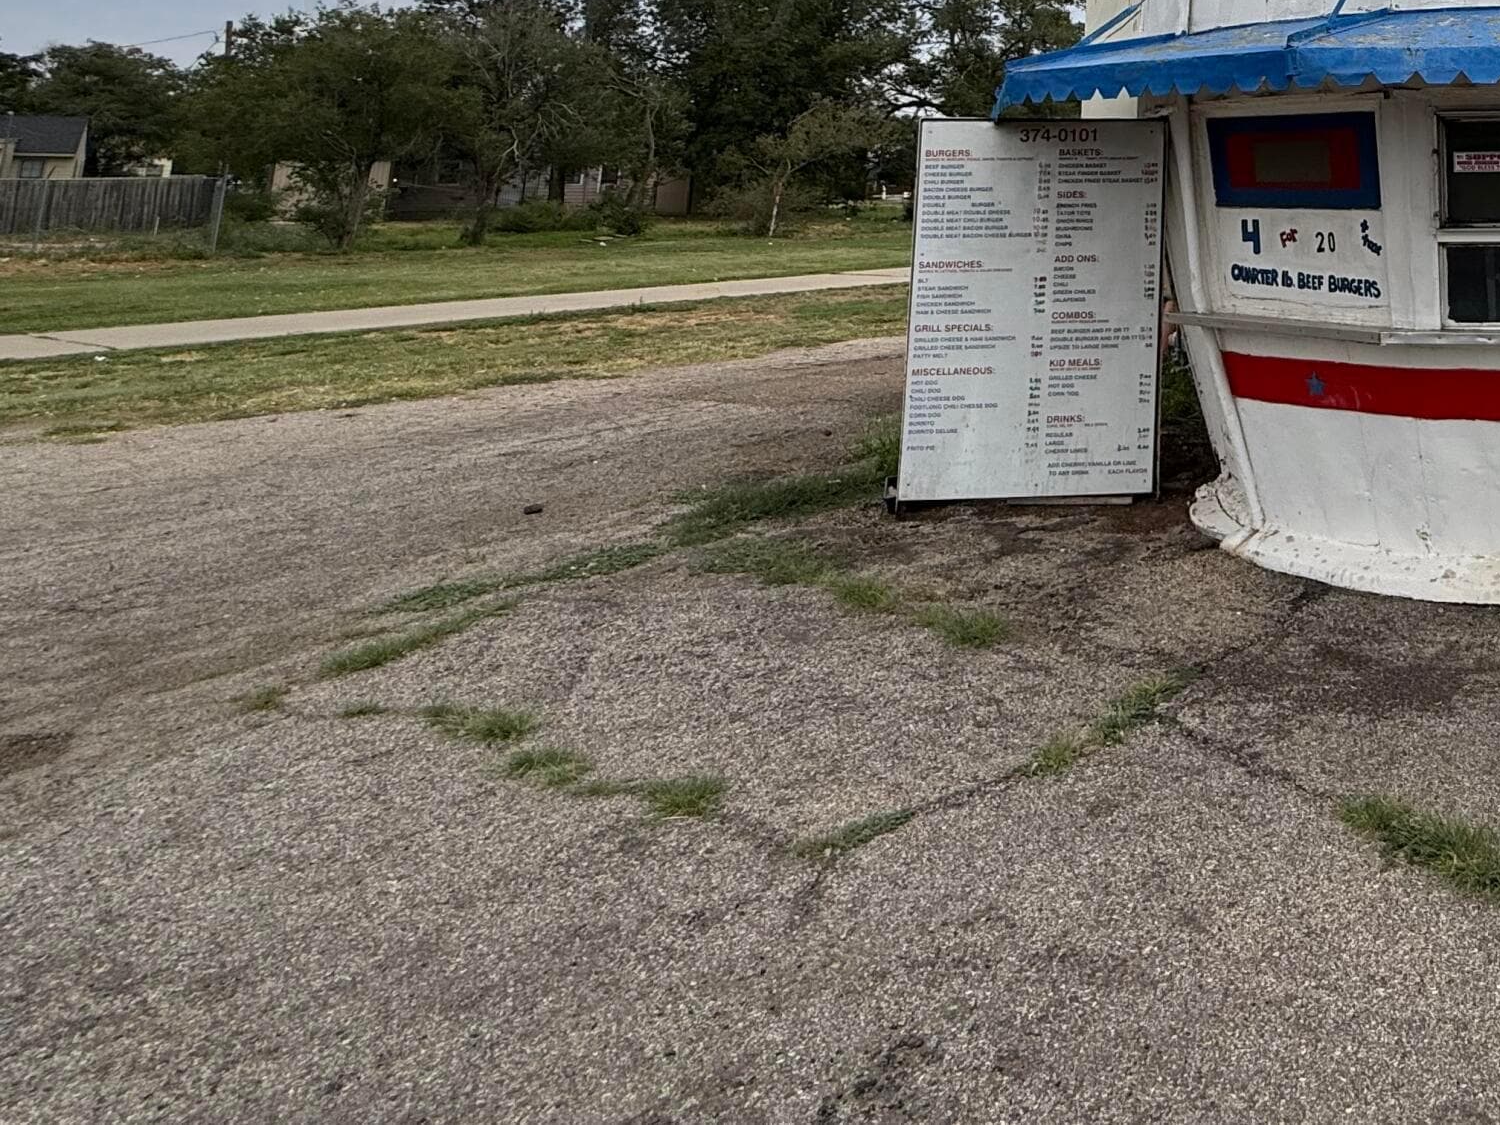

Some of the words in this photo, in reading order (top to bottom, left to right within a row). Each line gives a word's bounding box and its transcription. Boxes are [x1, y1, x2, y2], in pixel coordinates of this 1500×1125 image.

[1020, 128, 1098, 143] 374-0101
[1241, 219, 1261, 255] 4
[1315, 232, 1336, 253] 20
[1054, 255, 1074, 263] ADD
[1231, 264, 1279, 287] QUARTER
[1297, 272, 1324, 290] BEEF
[1328, 275, 1381, 299] BURGERS
[945, 324, 993, 332] SPECIALS:
[1049, 359, 1066, 367] KID
[1068, 358, 1102, 366] MEALS:
[1046, 415, 1085, 423] DRINKS:
